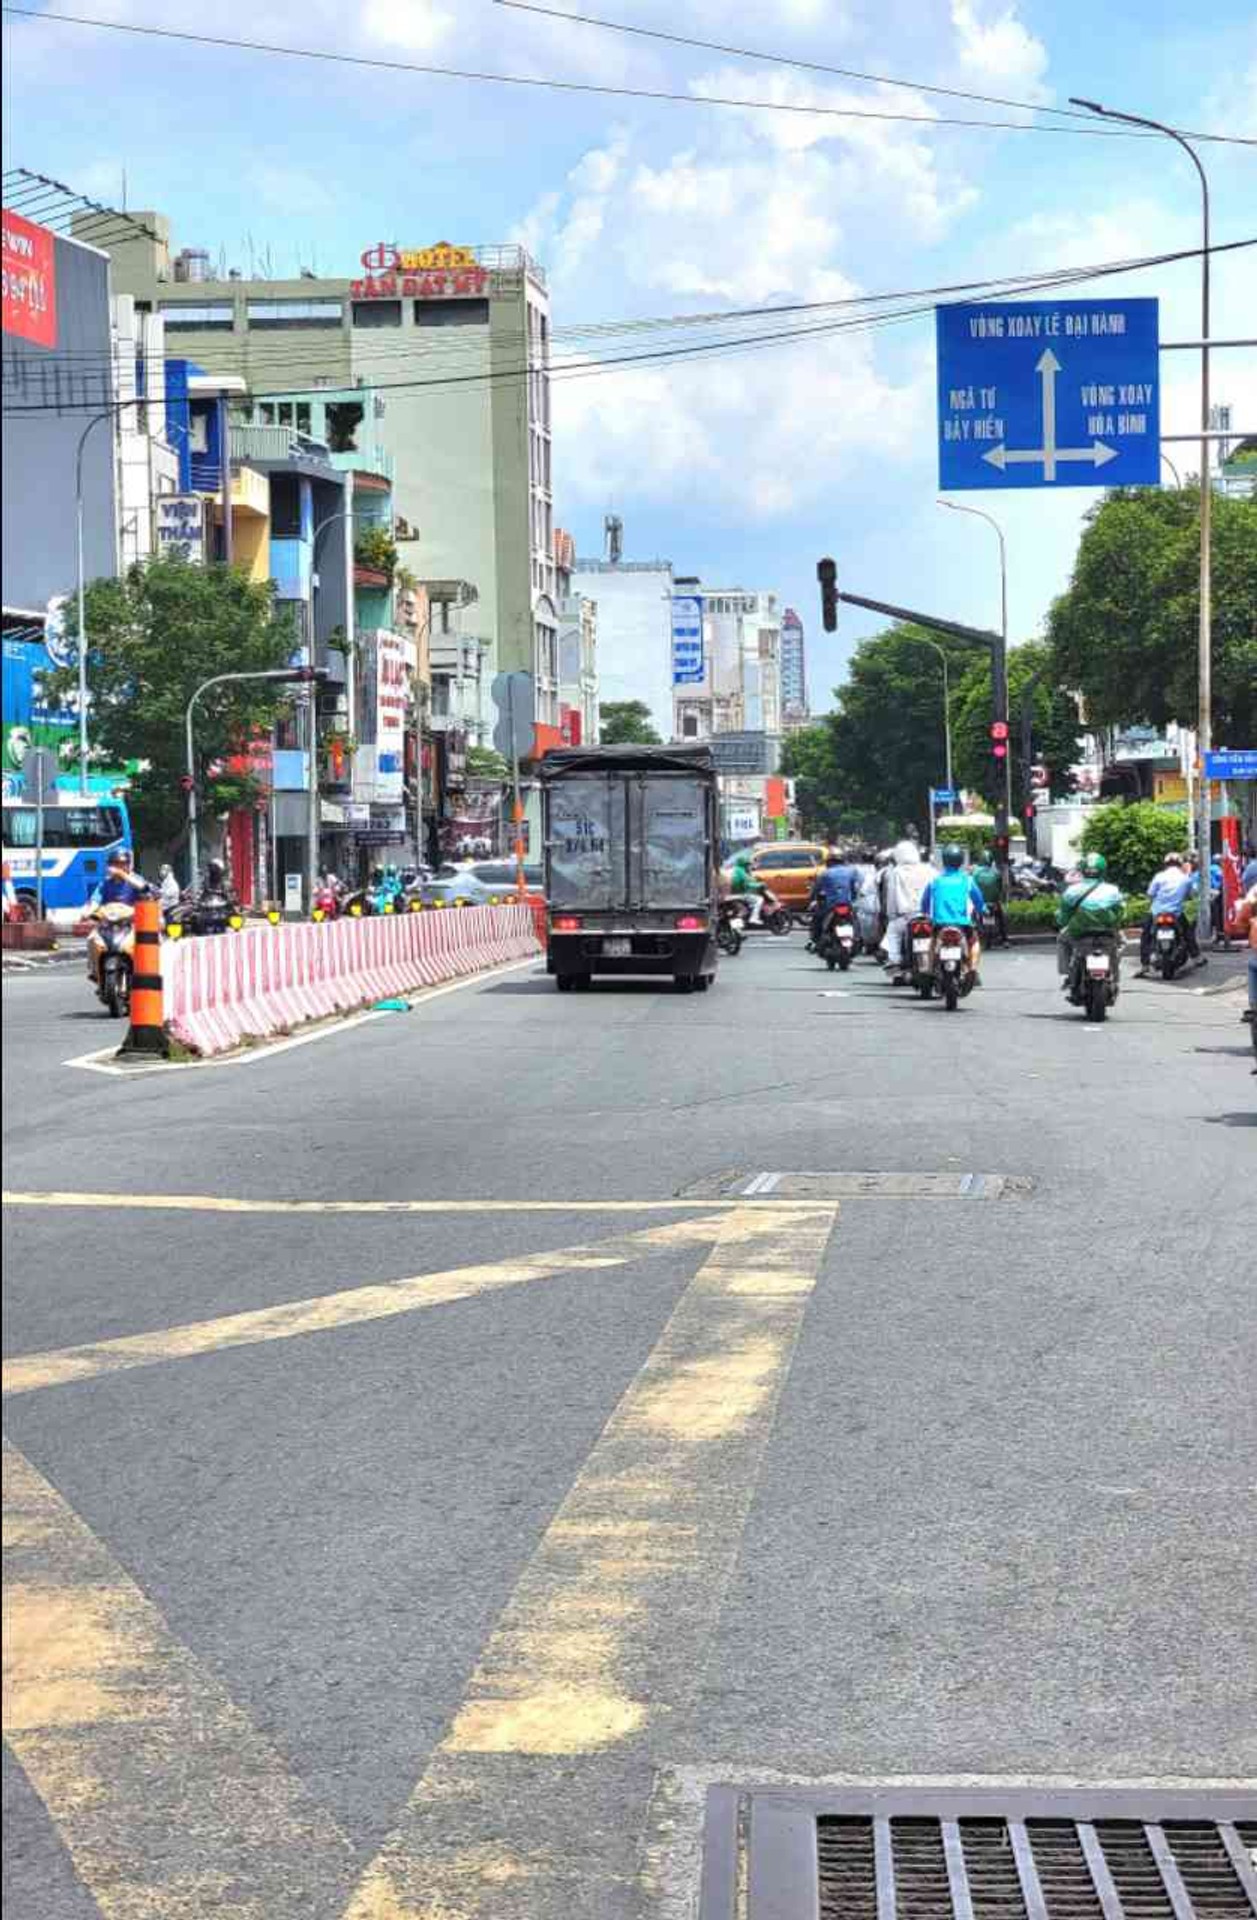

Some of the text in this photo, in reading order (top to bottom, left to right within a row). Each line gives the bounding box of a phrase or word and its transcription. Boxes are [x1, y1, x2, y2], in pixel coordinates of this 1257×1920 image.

[970, 311, 1126, 339] VÒNG XOAY LÊ ĐẠI HÀNH
[1081, 382, 1153, 407] VÒNG XOAY
[1117, 410, 1147, 434] BÌNH
[161, 501, 197, 519] VIỆN
